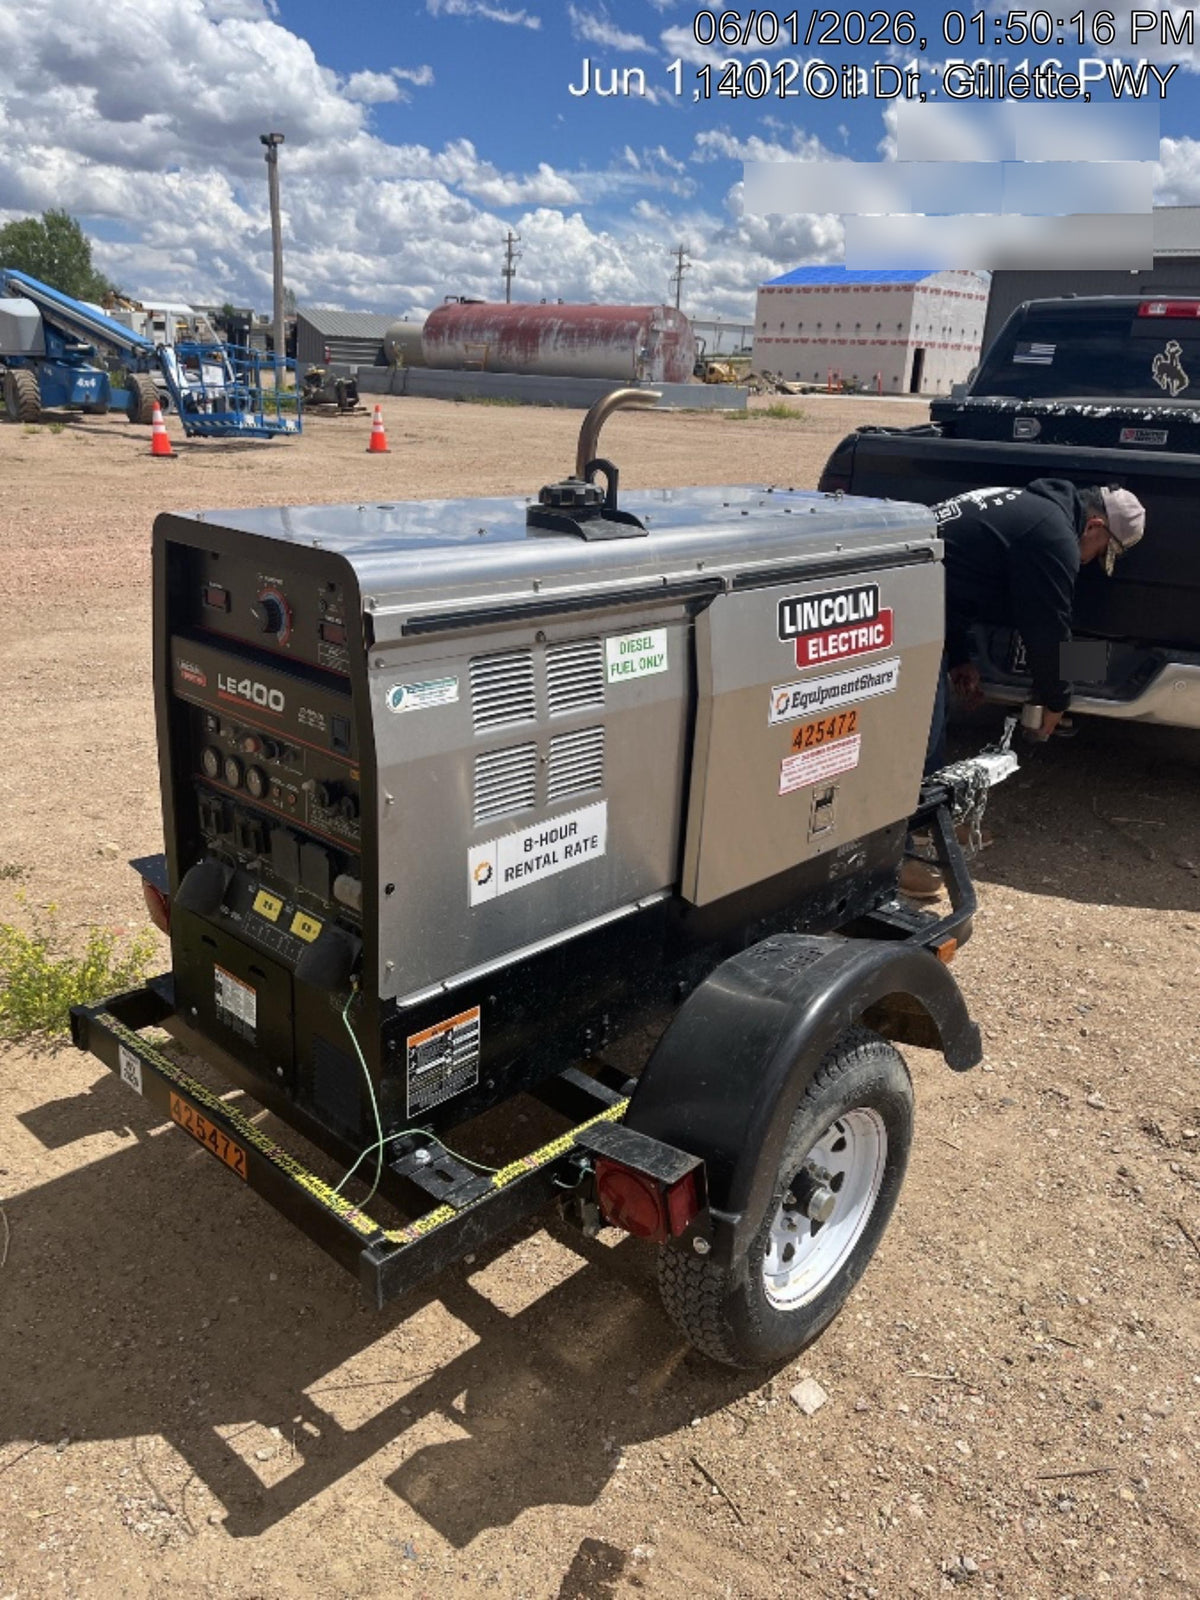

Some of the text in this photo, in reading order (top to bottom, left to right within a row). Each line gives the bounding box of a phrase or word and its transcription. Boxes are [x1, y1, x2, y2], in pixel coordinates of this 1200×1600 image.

[76, 377, 97, 388] 4x4
[783, 589, 875, 635] LINCOLN
[619, 635, 655, 656] DIESEL
[807, 623, 885, 661] ELECTRIC
[610, 653, 664, 677] FUEL ONLY
[216, 672, 286, 713] LE400
[791, 669, 895, 712] EquipmentShare
[792, 710, 857, 750] 425472
[523, 820, 578, 853] 8-HOUR
[504, 834, 599, 883] RENTAL RATE
[172, 1096, 246, 1177] 425472
